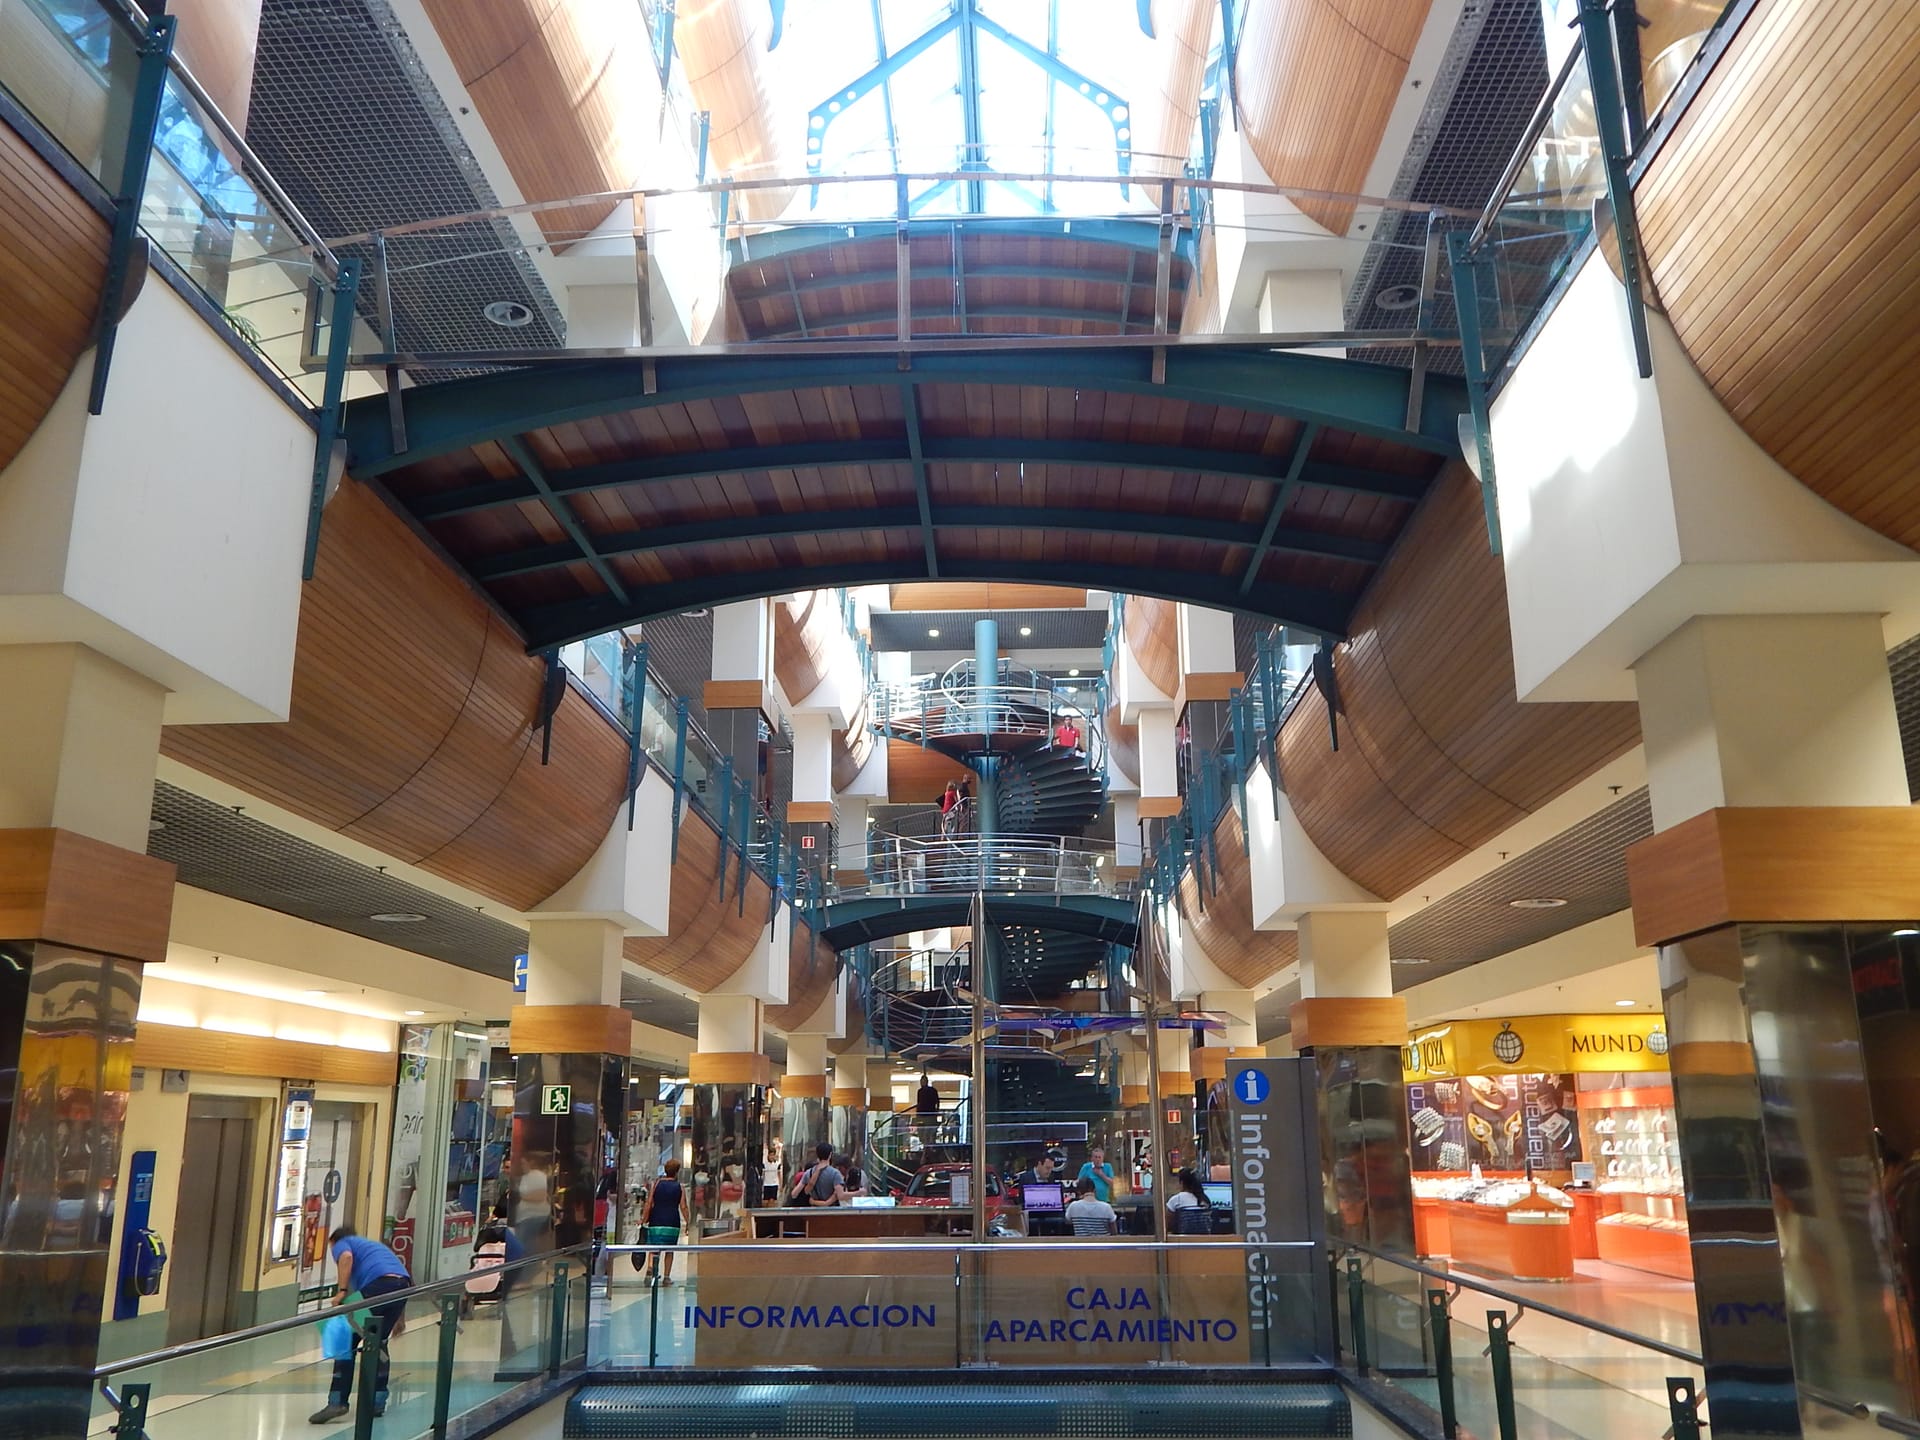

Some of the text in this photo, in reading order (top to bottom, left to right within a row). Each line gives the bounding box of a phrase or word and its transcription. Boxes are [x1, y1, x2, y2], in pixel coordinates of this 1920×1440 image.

[1423, 1040, 1446, 1075] JOYA
[1240, 1113, 1278, 1330] información
[1066, 1287, 1151, 1310] CAJA
[684, 1304, 936, 1329] INFORMACION
[984, 1319, 1238, 1342] APARCAMIENTO
